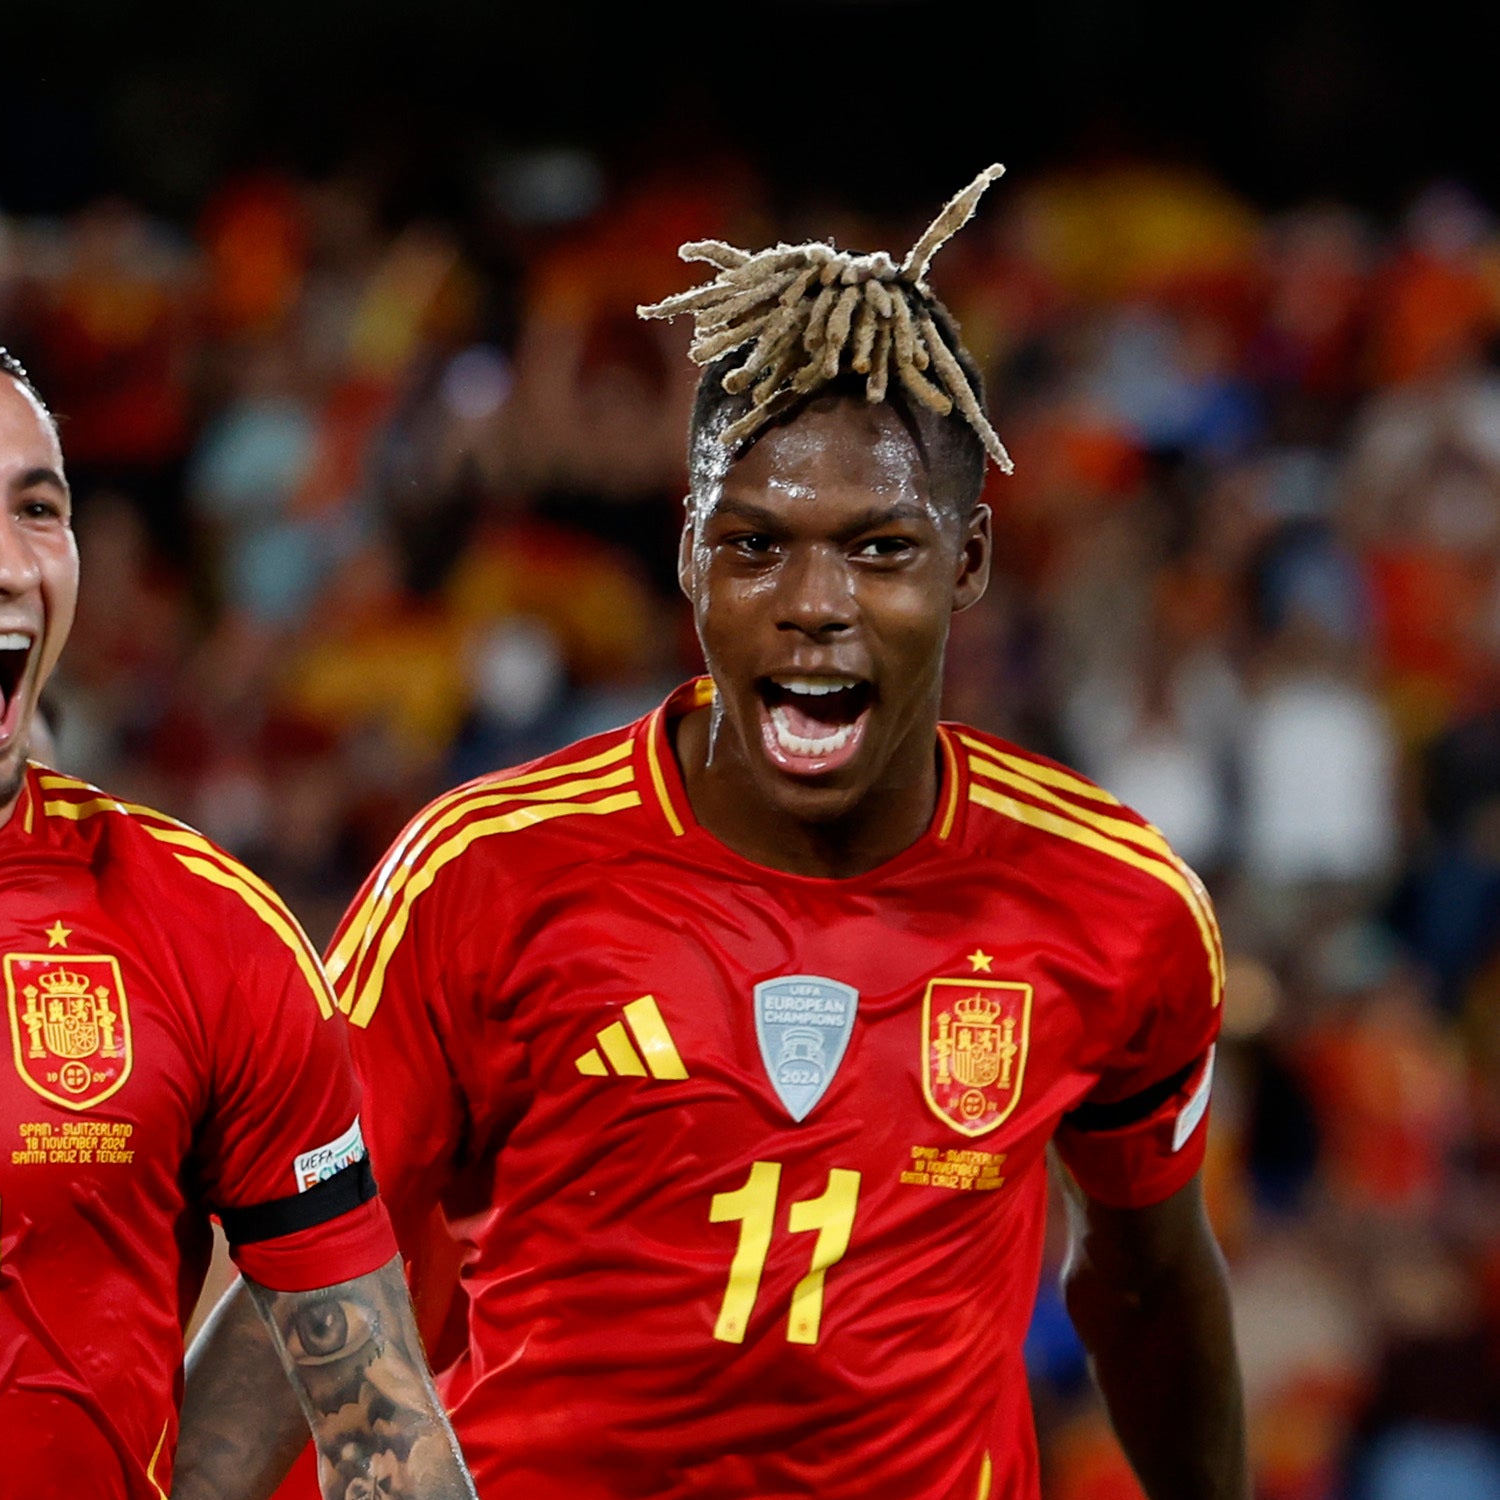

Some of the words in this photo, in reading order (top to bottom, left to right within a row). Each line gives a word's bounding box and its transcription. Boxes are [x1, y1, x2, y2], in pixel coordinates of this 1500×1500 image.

[790, 985, 821, 996] UEFA
[764, 996, 845, 1012] EUROPEAN
[764, 1011, 845, 1027] CHAMPIONS
[780, 1070, 820, 1084] 2024
[19, 1122, 52, 1136] SPAIN
[61, 1122, 133, 1137] SWITZERLAND
[41, 1137, 98, 1149] NOVEMBER
[101, 1137, 126, 1150] 2024
[11, 1150, 47, 1164] SANTA
[49, 1150, 77, 1163] CRUZ
[79, 1151, 92, 1163] DE
[95, 1150, 136, 1164] TENERIFE
[301, 1150, 332, 1171] UEFA
[709, 1161, 861, 1344] 11
